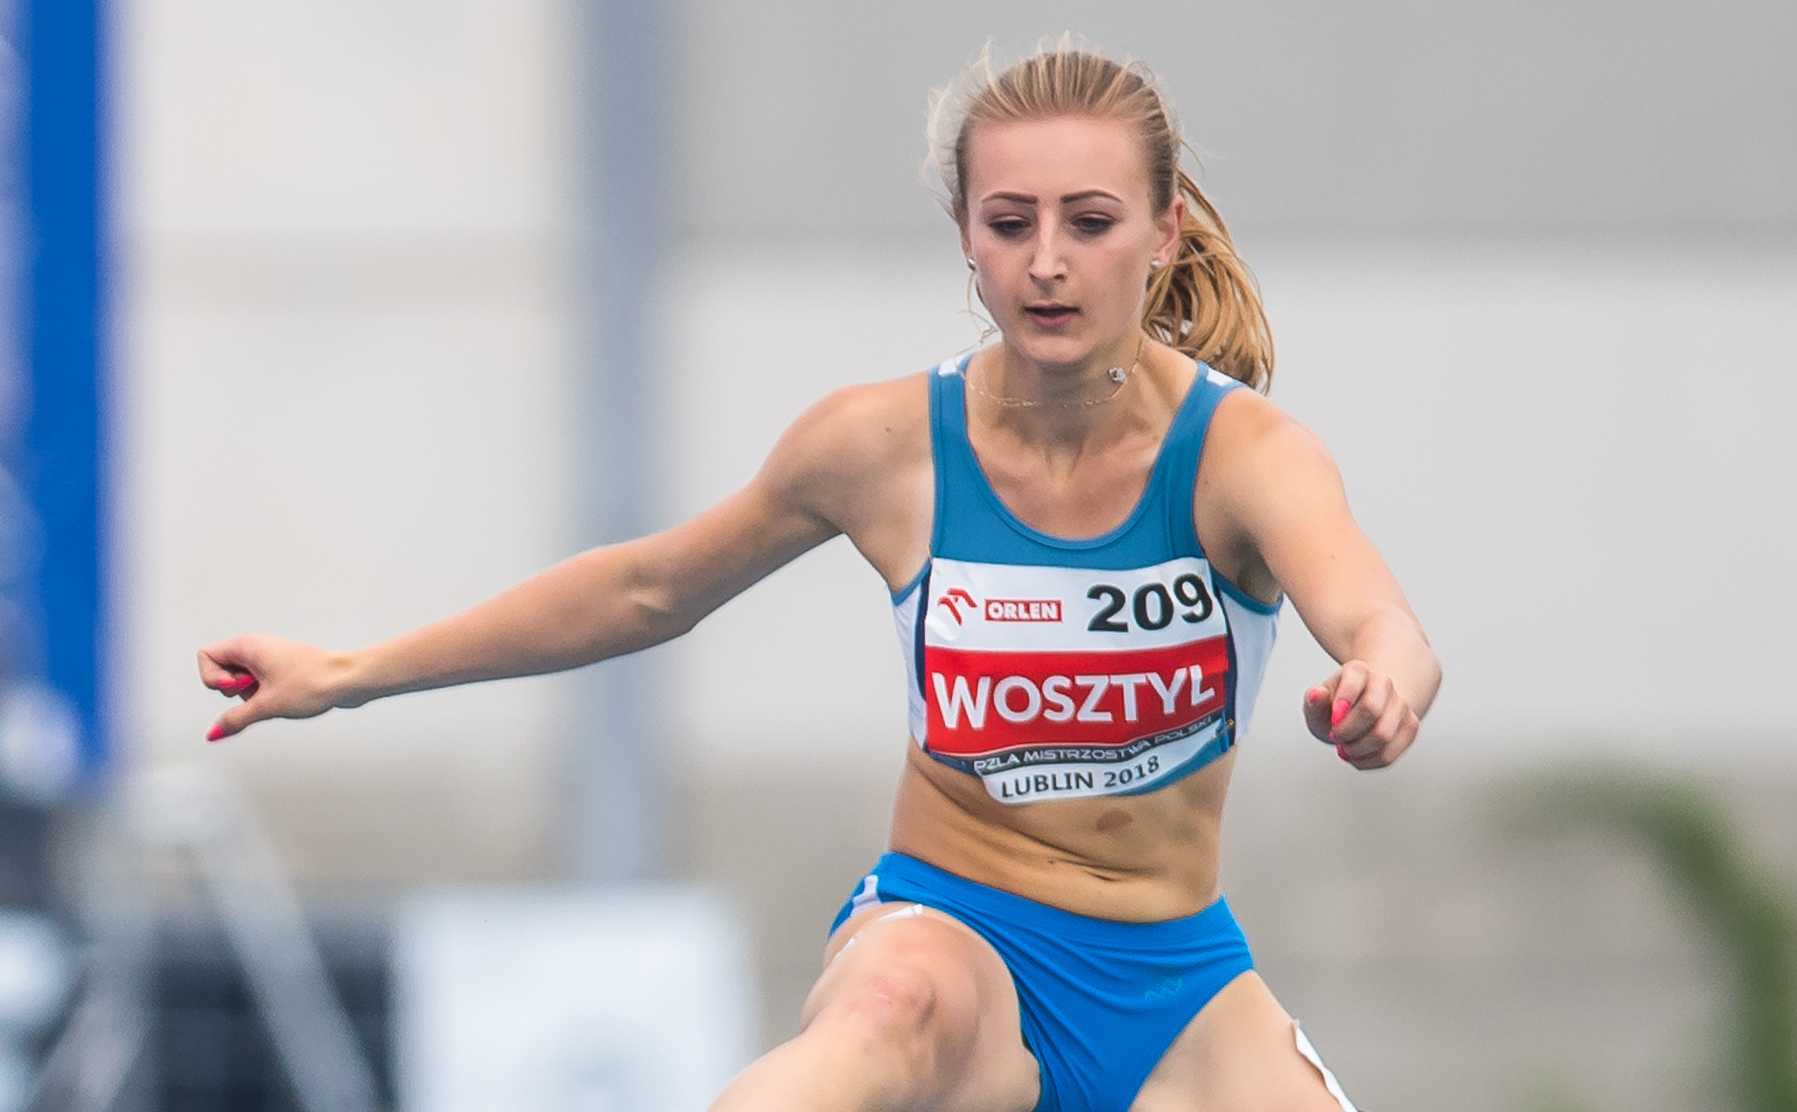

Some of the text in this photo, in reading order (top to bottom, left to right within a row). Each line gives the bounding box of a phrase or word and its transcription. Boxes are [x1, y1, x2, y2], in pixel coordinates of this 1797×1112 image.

[988, 601, 1058, 620] ORLEN
[1086, 573, 1214, 633] 209
[931, 664, 1215, 730] WOSZTYL
[973, 716, 1212, 773] PZLA MISTRZOSTWA POLSKI
[1001, 755, 1160, 798] LUBLIN 2018
